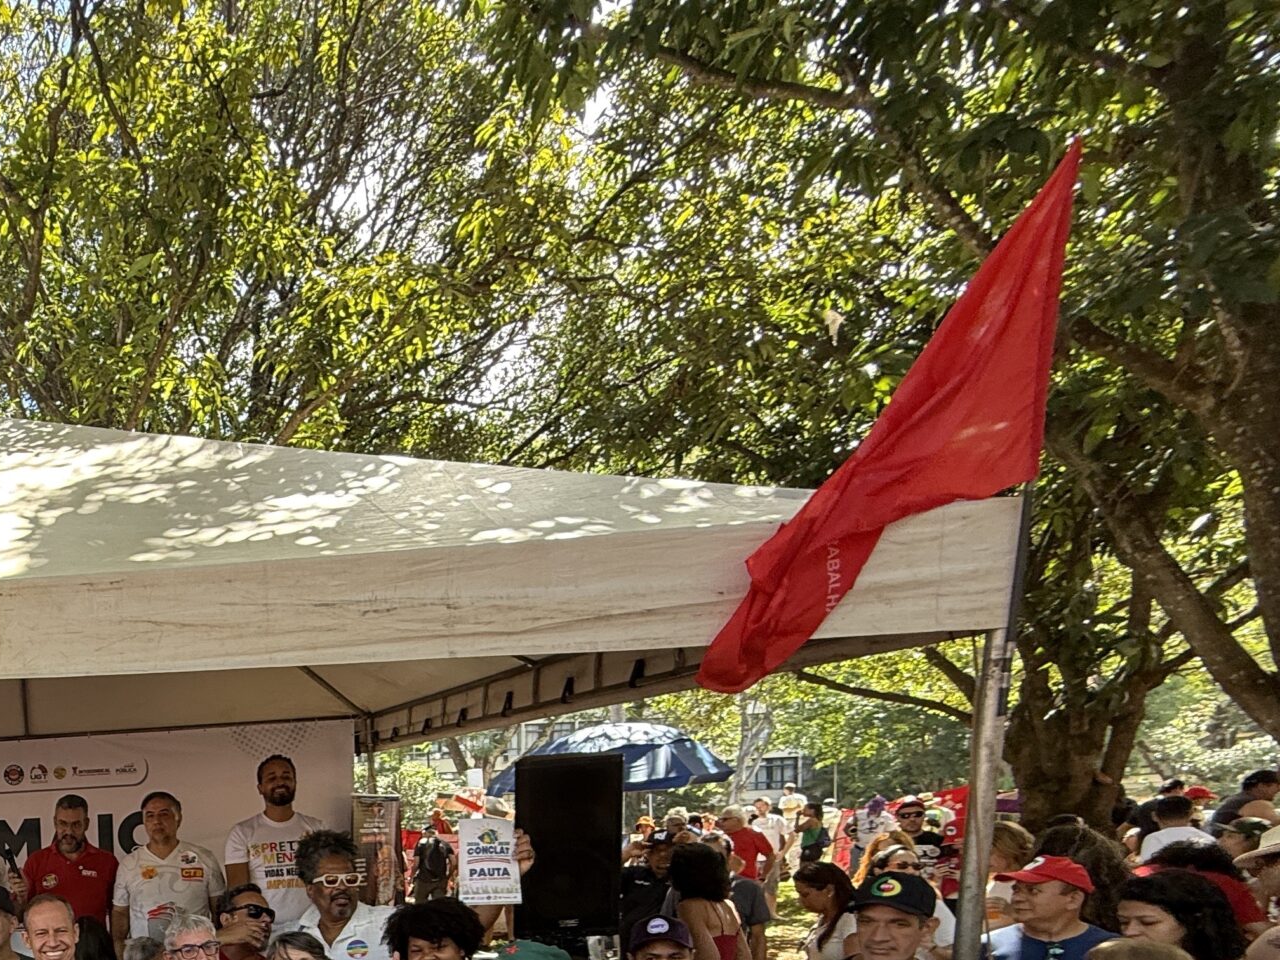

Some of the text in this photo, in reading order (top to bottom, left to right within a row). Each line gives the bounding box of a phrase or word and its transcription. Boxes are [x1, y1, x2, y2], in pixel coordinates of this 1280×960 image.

[825, 541, 840, 612] ABALH
[467, 846, 510, 855] CONCLAT
[183, 869, 203, 877] CTB
[265, 868, 284, 878] VIDAS
[469, 868, 510, 877] PAUTA
